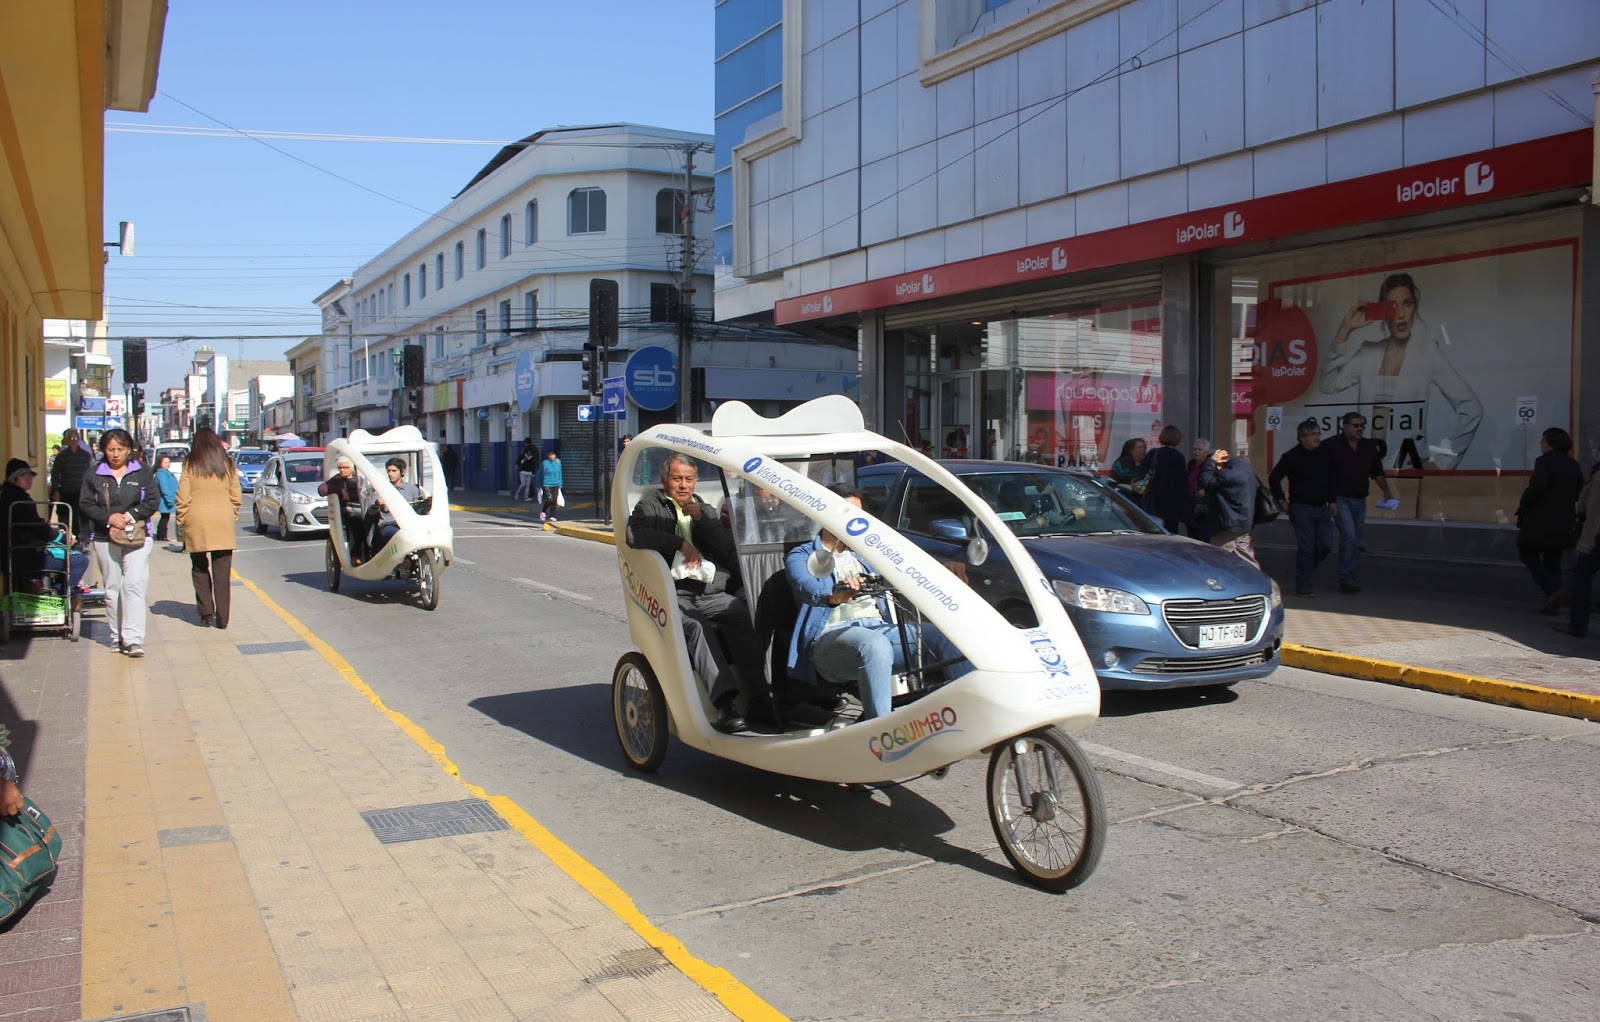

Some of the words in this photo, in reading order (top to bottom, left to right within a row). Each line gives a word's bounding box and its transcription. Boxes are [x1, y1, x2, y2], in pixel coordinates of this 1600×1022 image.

[1397, 177, 1459, 203] laPolar
[1176, 223, 1221, 244] laPolar
[1017, 256, 1050, 273] laPolar
[896, 281, 921, 296] laPolar
[802, 302, 822, 314] laPolar
[517, 368, 532, 390] sb
[633, 364, 676, 387] sb
[1272, 366, 1306, 377] laPolar
[1268, 415, 1281, 425] 60
[1308, 408, 1424, 435] spcial
[1518, 406, 1535, 418] 60
[756, 465, 780, 484] Visita
[778, 479, 827, 512] Coquimbo
[869, 706, 957, 761] COQUIMBO
